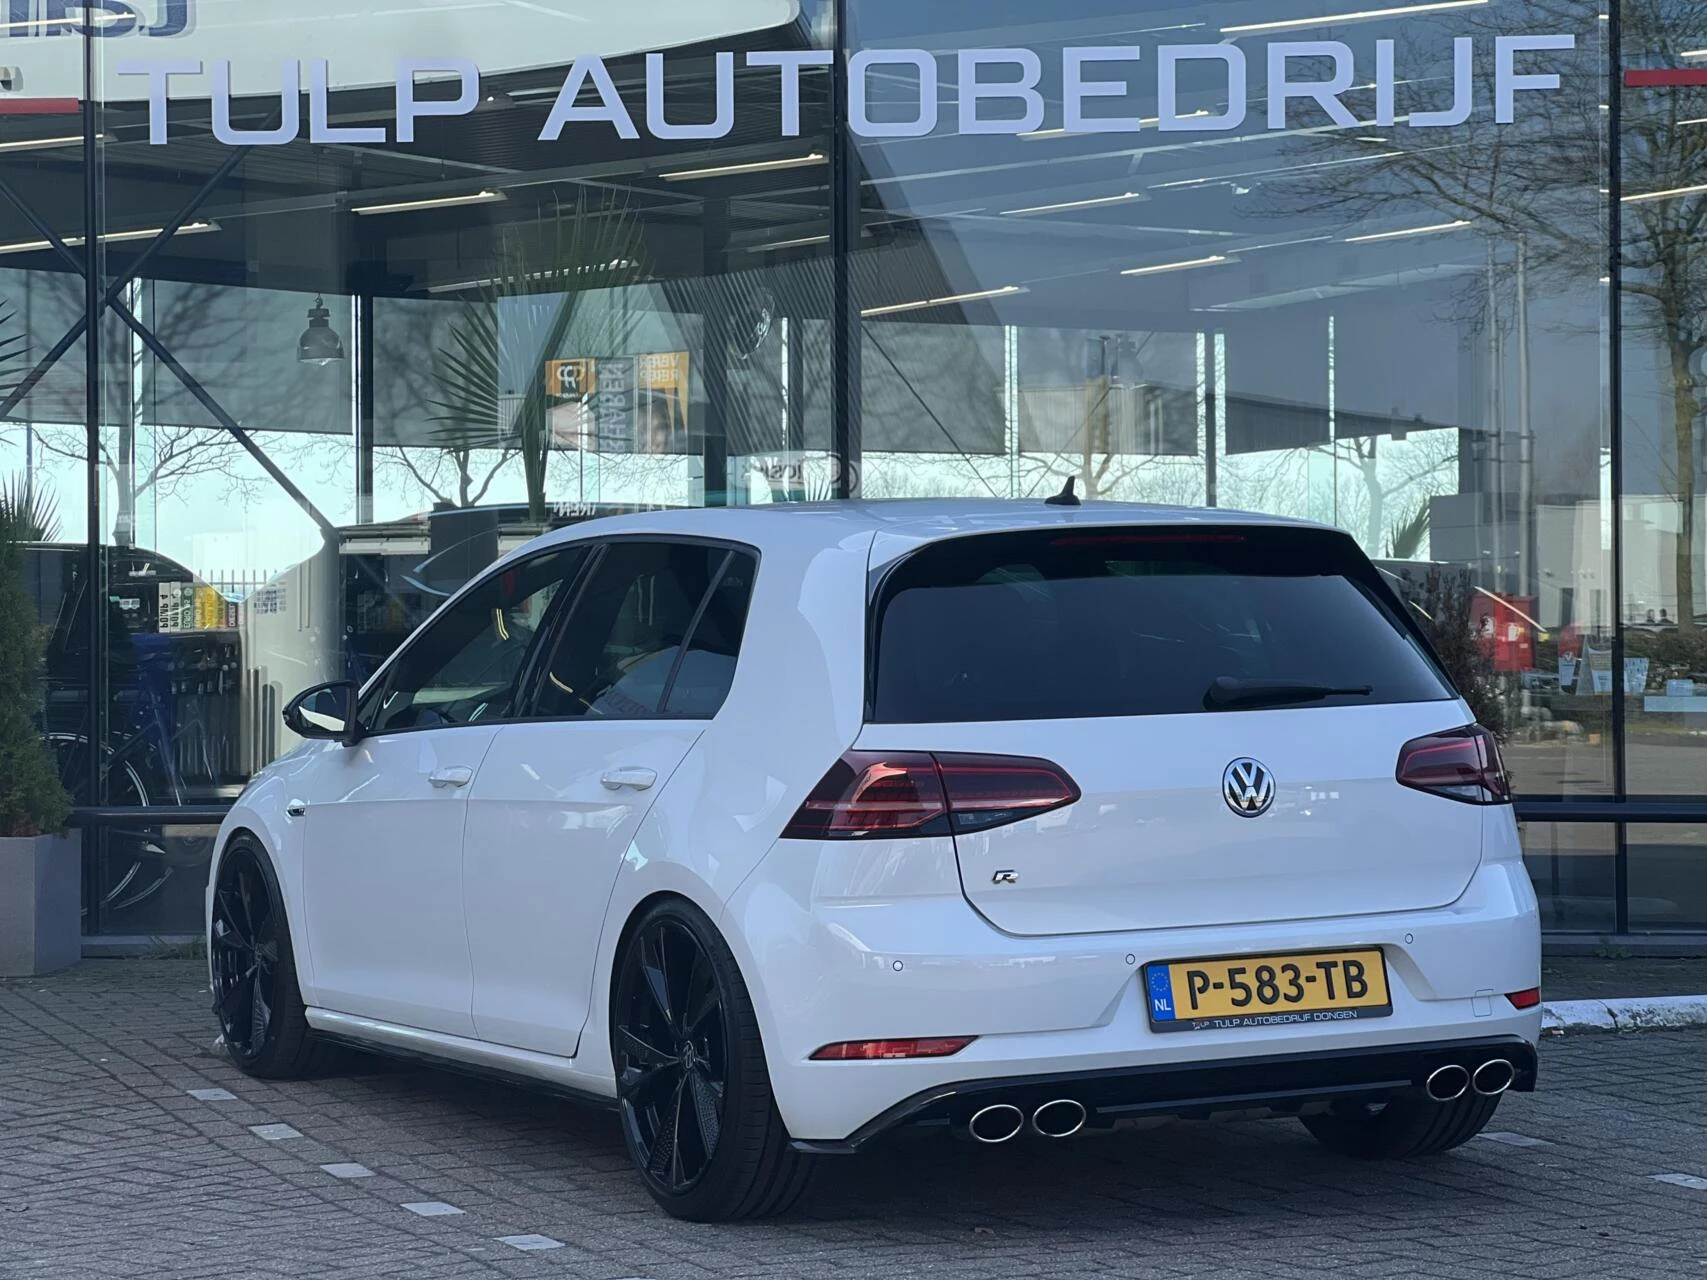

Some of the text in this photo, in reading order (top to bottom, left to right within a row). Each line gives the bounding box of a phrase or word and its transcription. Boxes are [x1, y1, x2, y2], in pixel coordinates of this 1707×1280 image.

[116, 33, 1576, 146] TULP AUTOBEDRIJF
[992, 869, 1019, 884] R
[1186, 959, 1368, 1010] P-583-TB
[1154, 998, 1172, 1011] NL
[1214, 1018, 1241, 1029] TULP
[1242, 1013, 1311, 1027] AUTOBEDRIJF
[1314, 1010, 1358, 1021] DONGEN
